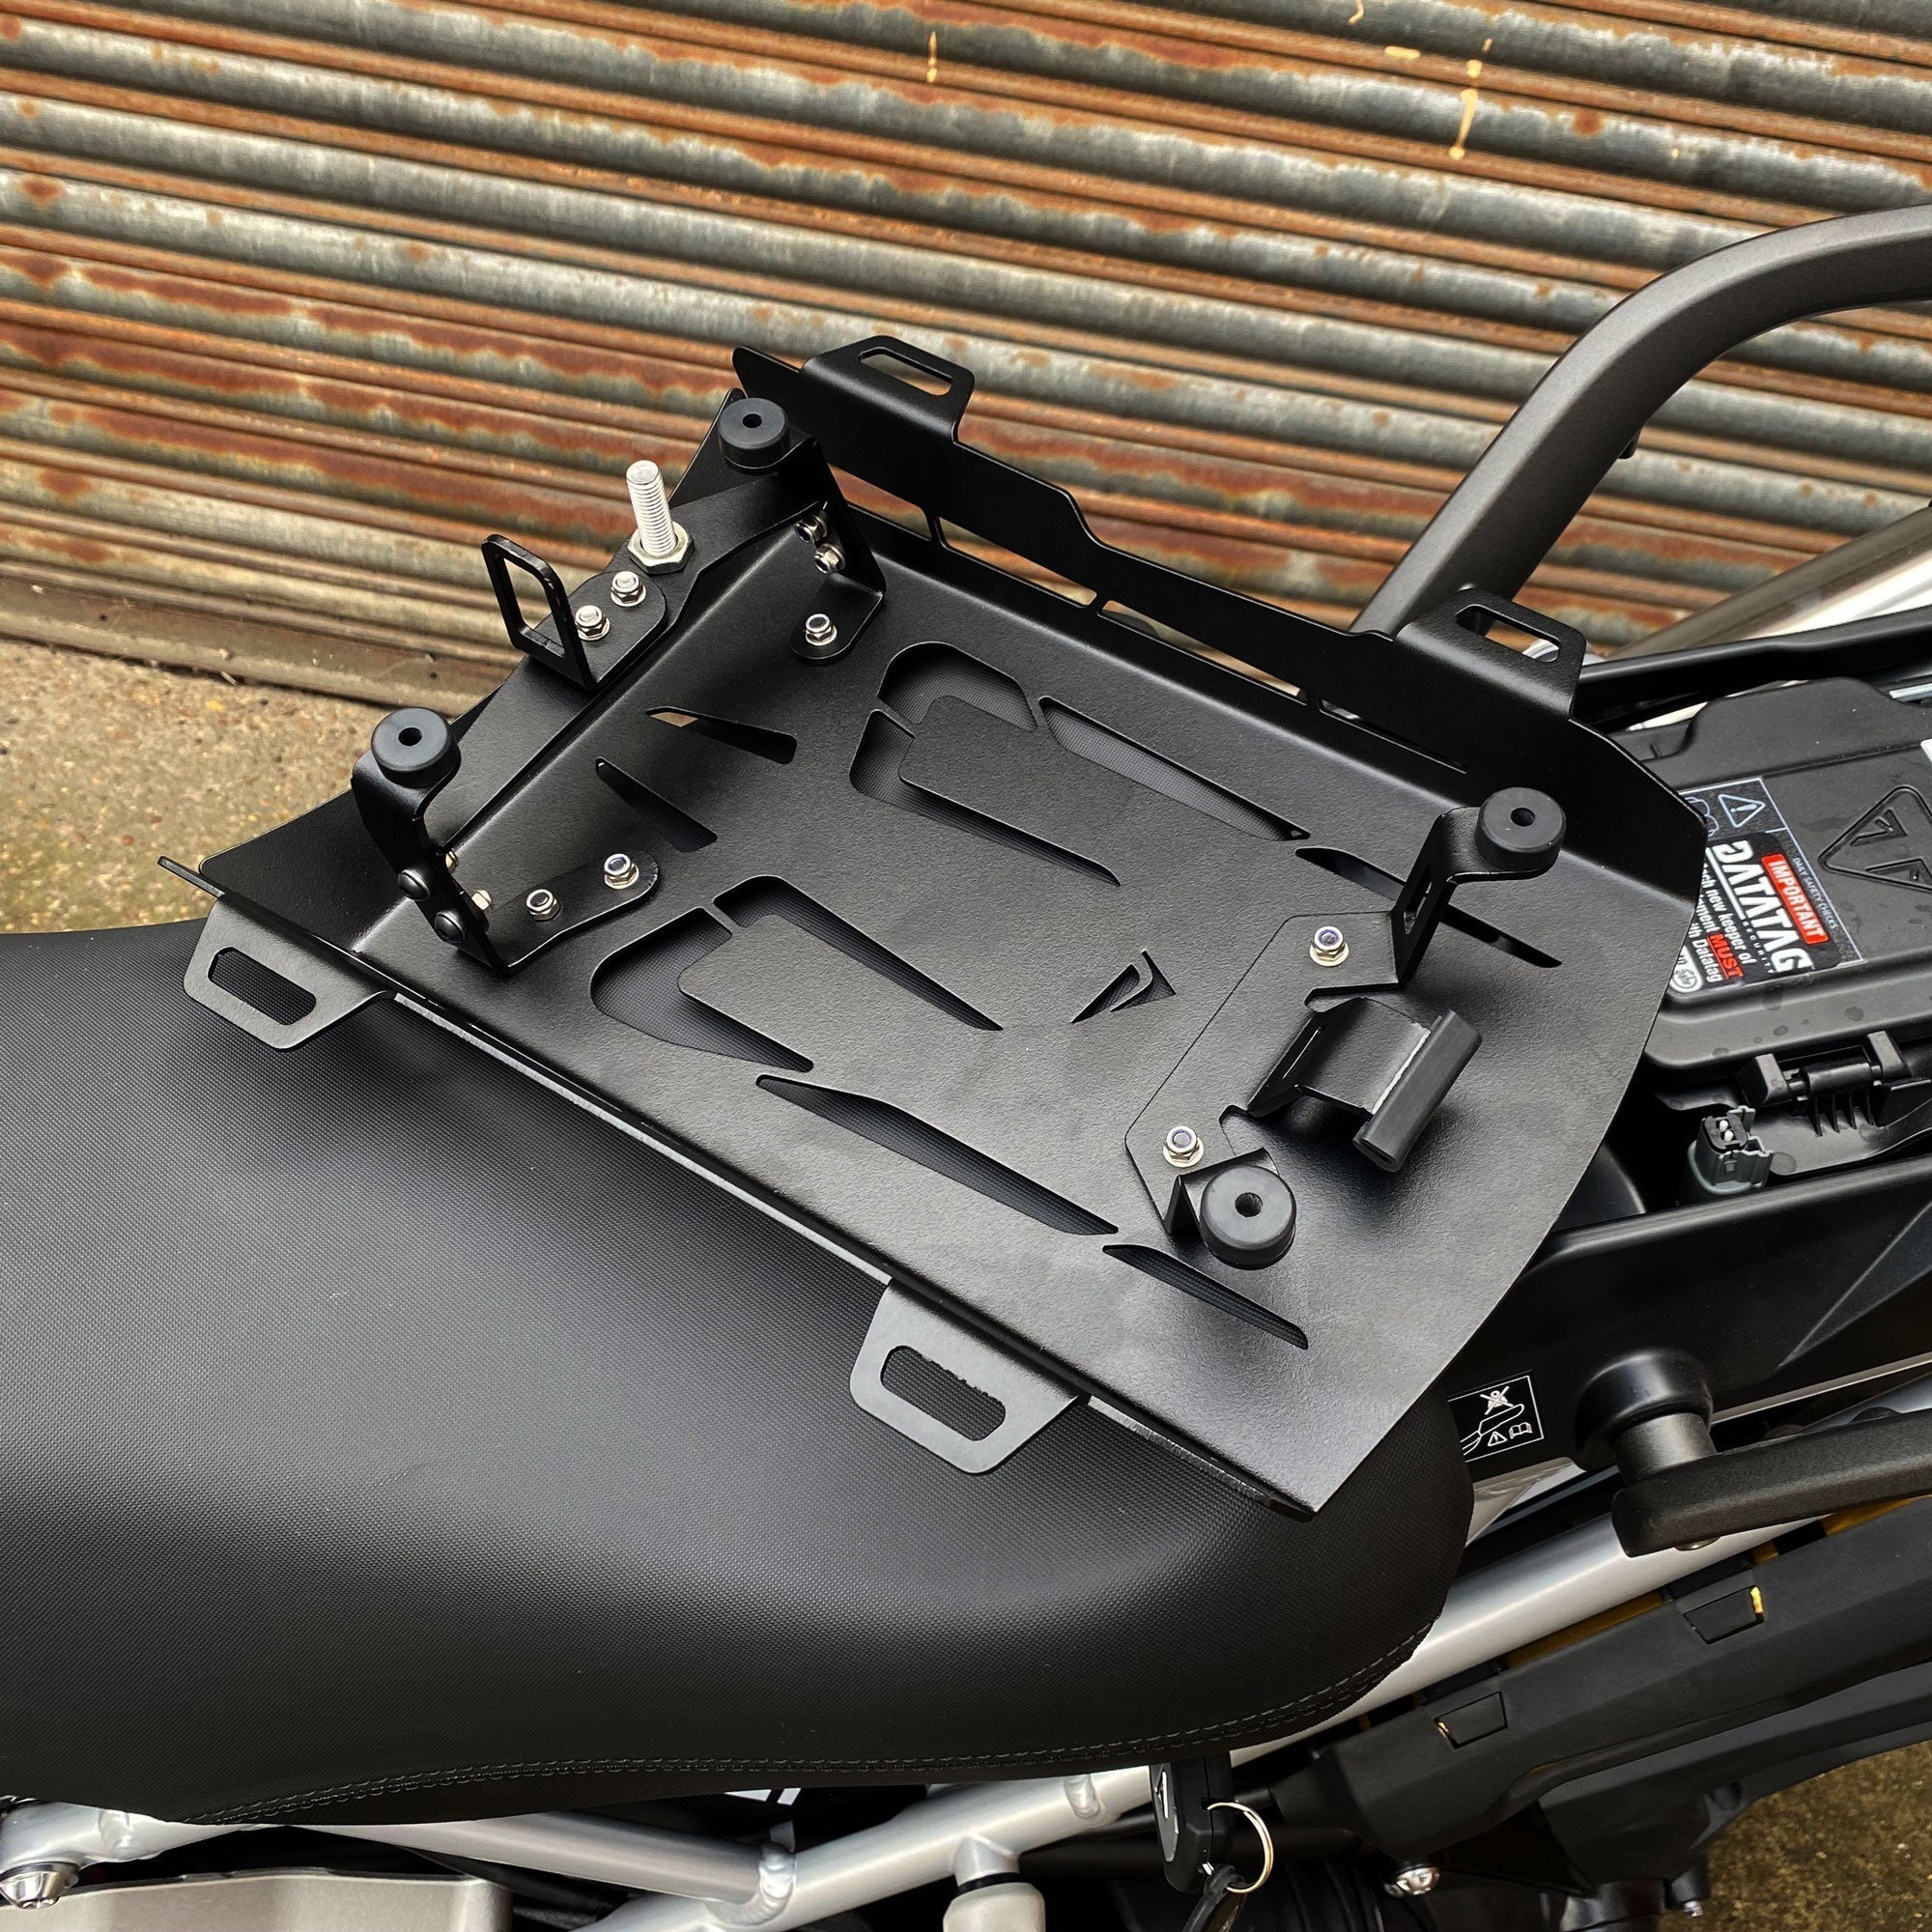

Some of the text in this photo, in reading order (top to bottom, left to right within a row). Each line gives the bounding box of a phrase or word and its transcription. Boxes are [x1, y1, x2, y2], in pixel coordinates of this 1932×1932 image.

[1705, 889, 1727, 912] new
[1718, 913, 1751, 952] keeper
[1739, 952, 1757, 964] of
[1712, 839, 1813, 973] DATATAG
[1769, 860, 1826, 937] IMPORTANT
[1793, 857, 1838, 929] DAILY SAFETY CHECKS
[1691, 938, 1723, 982] Datatag
[1707, 933, 1744, 979] MUST
[1742, 920, 1775, 974] SECURITY
